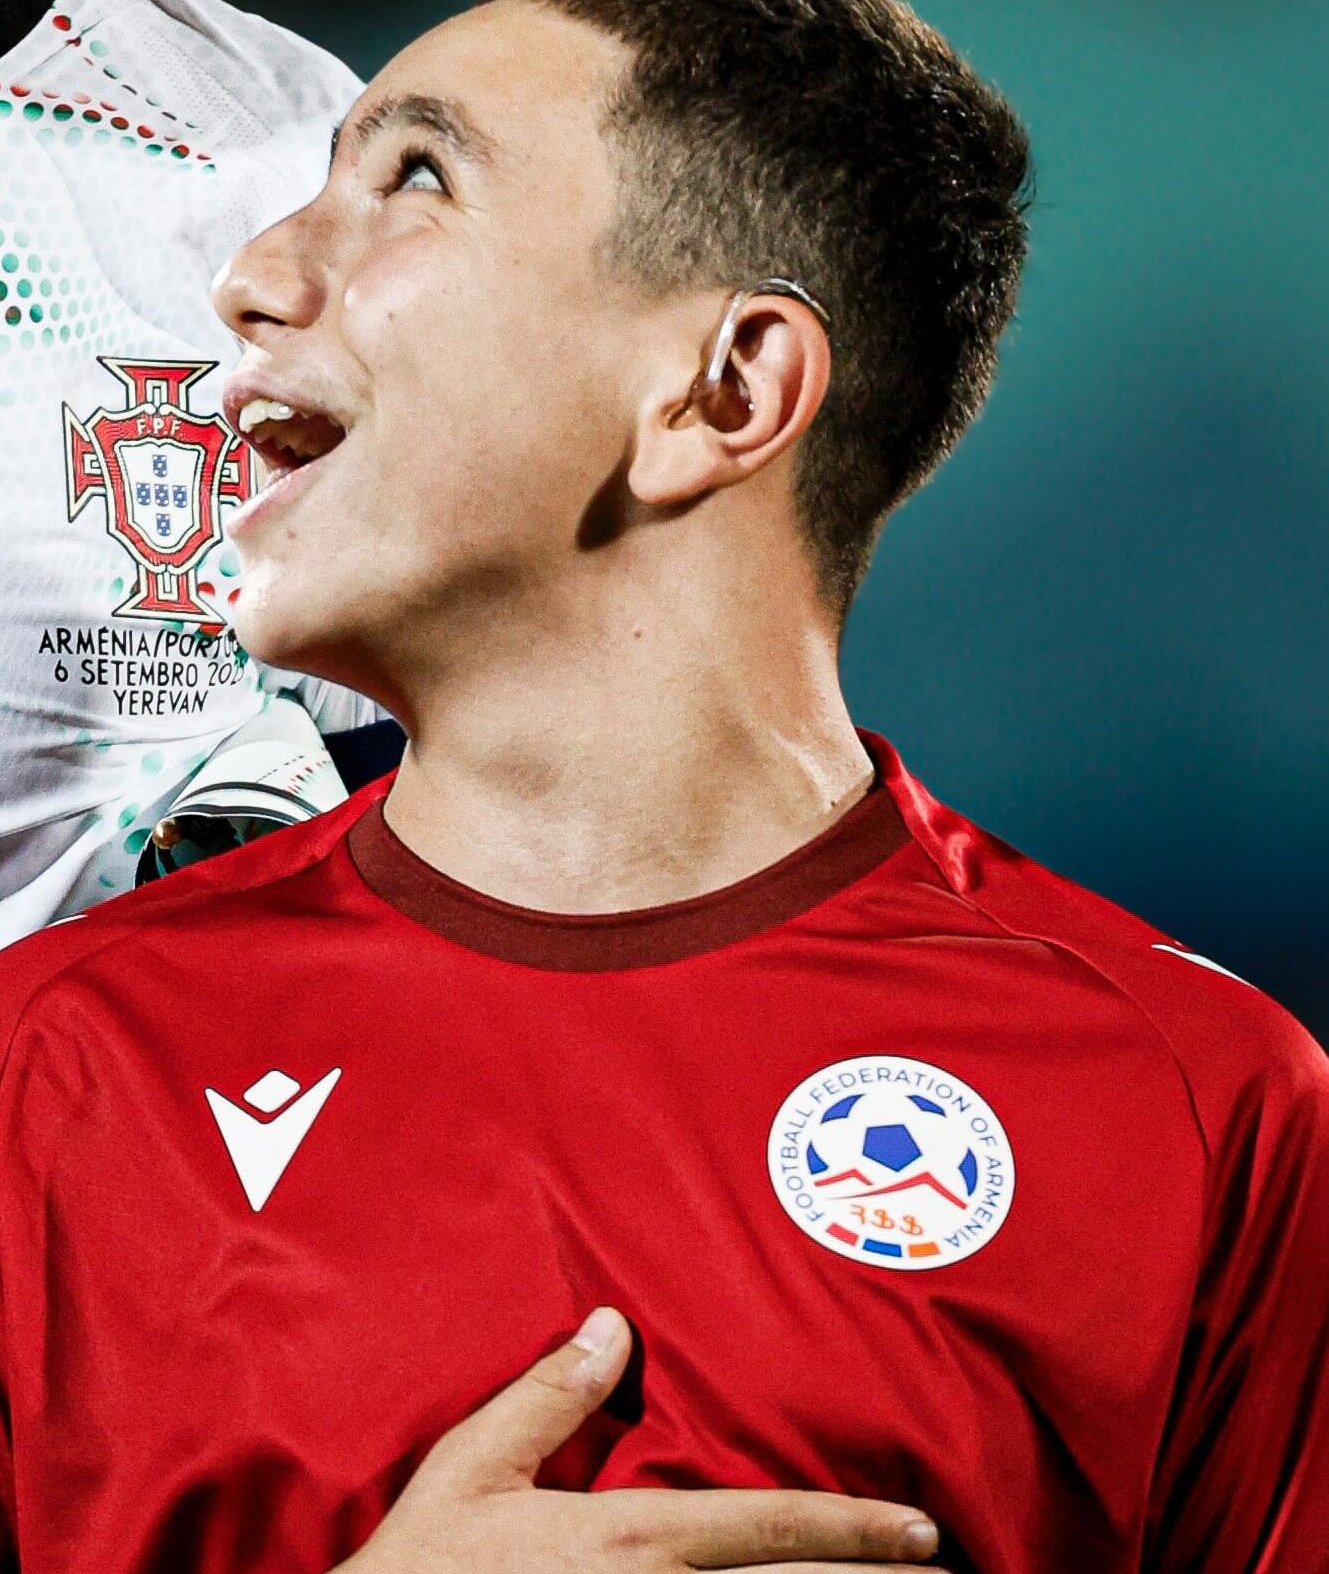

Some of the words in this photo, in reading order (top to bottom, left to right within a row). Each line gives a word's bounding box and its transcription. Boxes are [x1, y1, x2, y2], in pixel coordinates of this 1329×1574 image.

[54, 659, 69, 683] 6
[80, 658, 199, 687] SETEMBRO
[113, 689, 209, 716] YEREVAN
[809, 1066, 971, 1114] FEDERATION
[970, 1116, 999, 1149] OF
[781, 1108, 825, 1223] FOOTBALL
[943, 1154, 1005, 1249] ARMENIA
